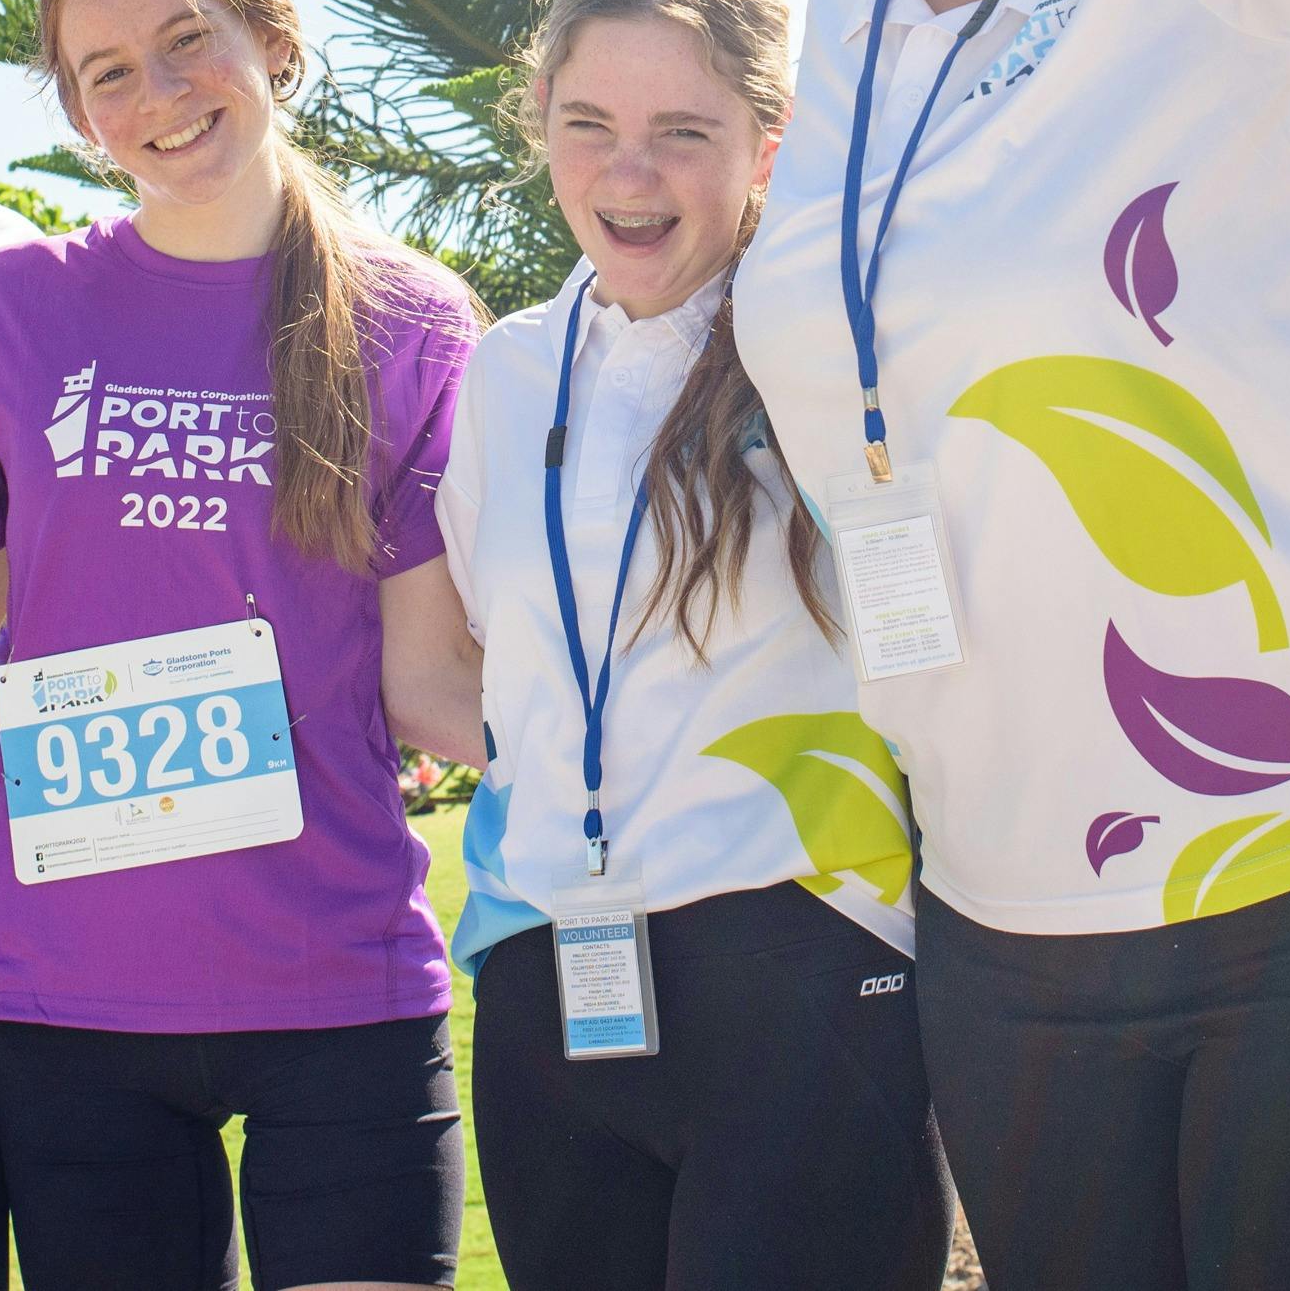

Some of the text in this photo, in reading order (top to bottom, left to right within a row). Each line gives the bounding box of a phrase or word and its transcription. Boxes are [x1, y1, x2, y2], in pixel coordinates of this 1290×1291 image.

[105, 383, 164, 396] Gladstone
[167, 388, 198, 399] Ports
[99, 395, 277, 436] PORT to
[95, 429, 276, 486] PARK
[120, 493, 228, 532] 2022
[166, 648, 231, 665] Gladstone Ports
[167, 659, 216, 673] Corporation
[48, 674, 101, 692] PORT to
[50, 686, 104, 711] PARK
[36, 694, 250, 807] 9328
[560, 918, 578, 926] PORT
[591, 915, 611, 923] PARK
[612, 914, 629, 922] 2022
[563, 927, 629, 942] VOLUNTEER
